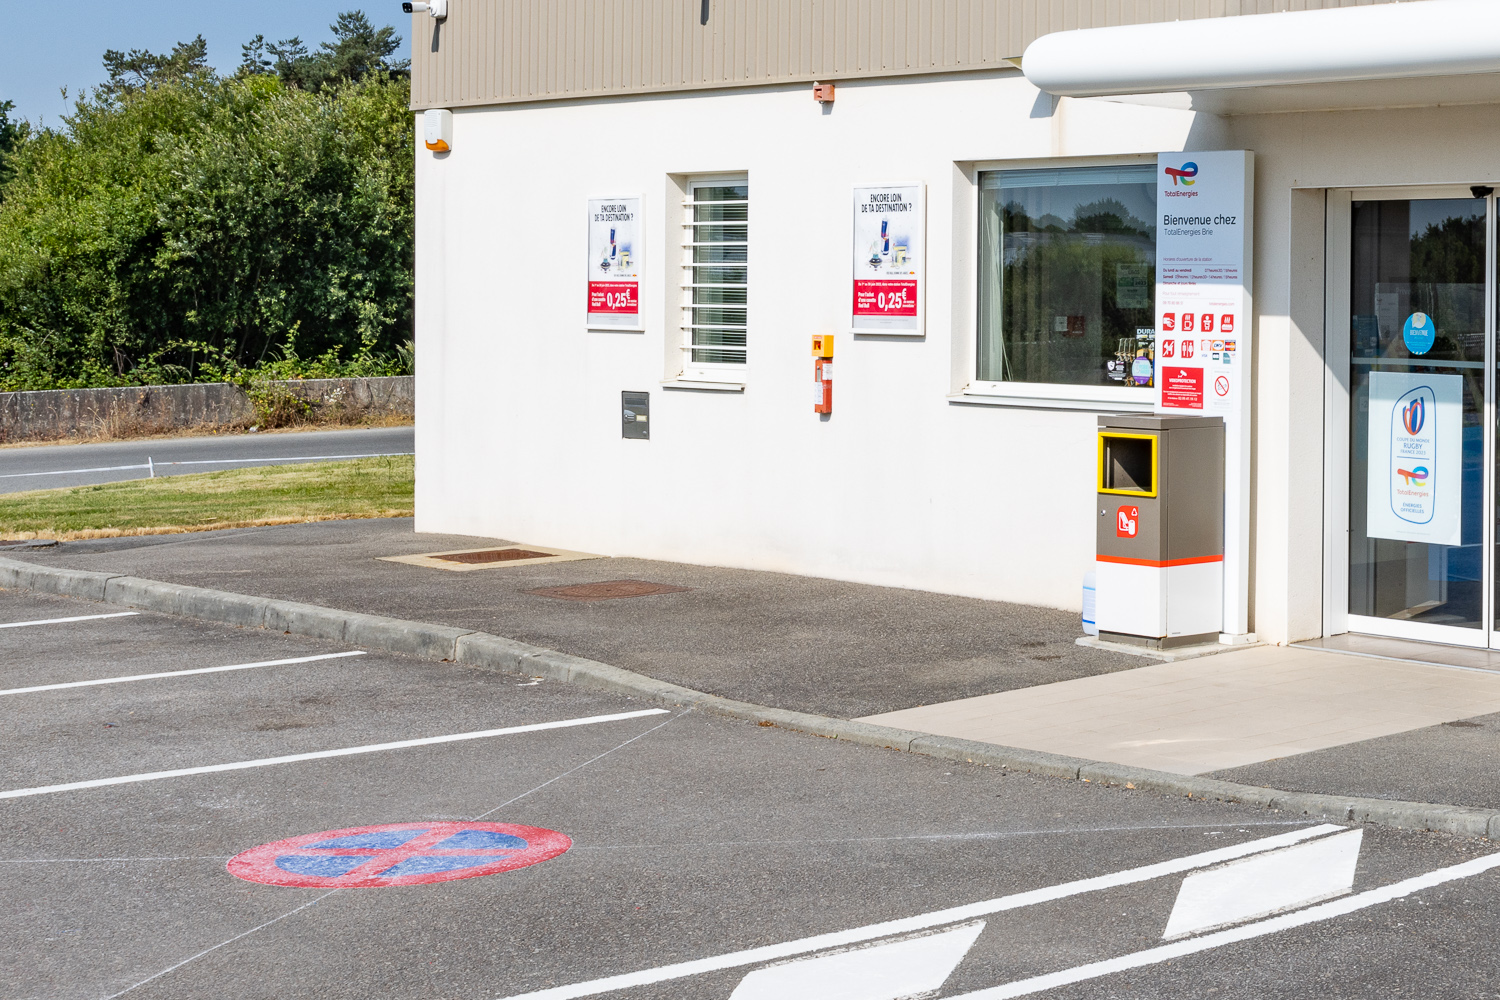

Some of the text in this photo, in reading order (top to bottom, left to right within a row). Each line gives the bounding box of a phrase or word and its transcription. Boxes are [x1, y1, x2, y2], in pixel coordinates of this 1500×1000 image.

[870, 193, 902, 203] ENCORE LOIN
[1164, 190, 1198, 199] TotalEnergies
[601, 204, 627, 213] ENCORE LOIN
[861, 204, 867, 213] DE
[875, 203, 908, 213] DESTINATION
[605, 213, 630, 222] DESTINATION
[1163, 213, 1236, 226] Bienvenue chez
[1164, 227, 1214, 237] TotalEnergies Brie
[606, 289, 631, 310] 0,25€
[877, 288, 907, 312] 0,25€
[1403, 442, 1423, 450] RUGBY
[1396, 489, 1429, 498] TotalEnergies
